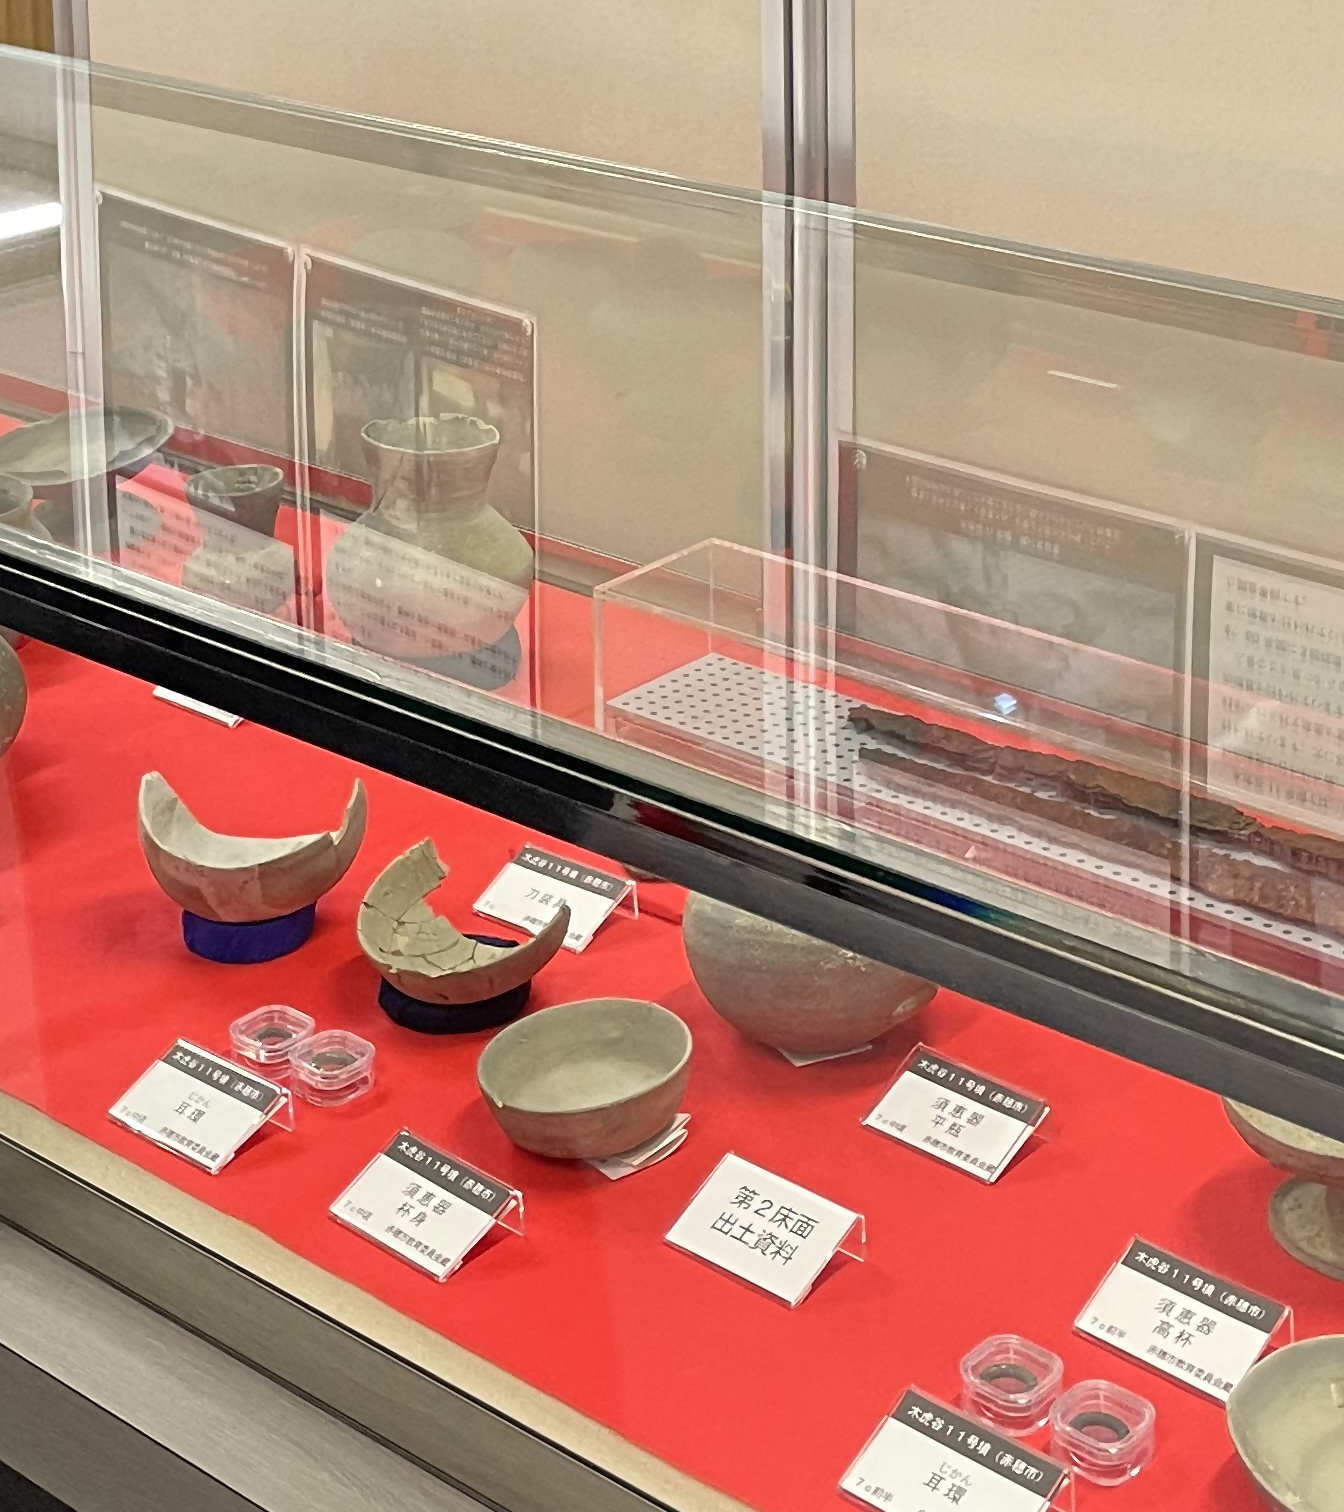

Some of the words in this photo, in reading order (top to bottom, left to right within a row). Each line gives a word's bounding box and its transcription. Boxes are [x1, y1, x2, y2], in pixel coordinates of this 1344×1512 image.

[730, 1185, 820, 1239] 第2床面
[710, 1211, 799, 1266] 出土資料
[1154, 1298, 1217, 1335] 須恵器
[923, 1472, 967, 1505] 耳環
